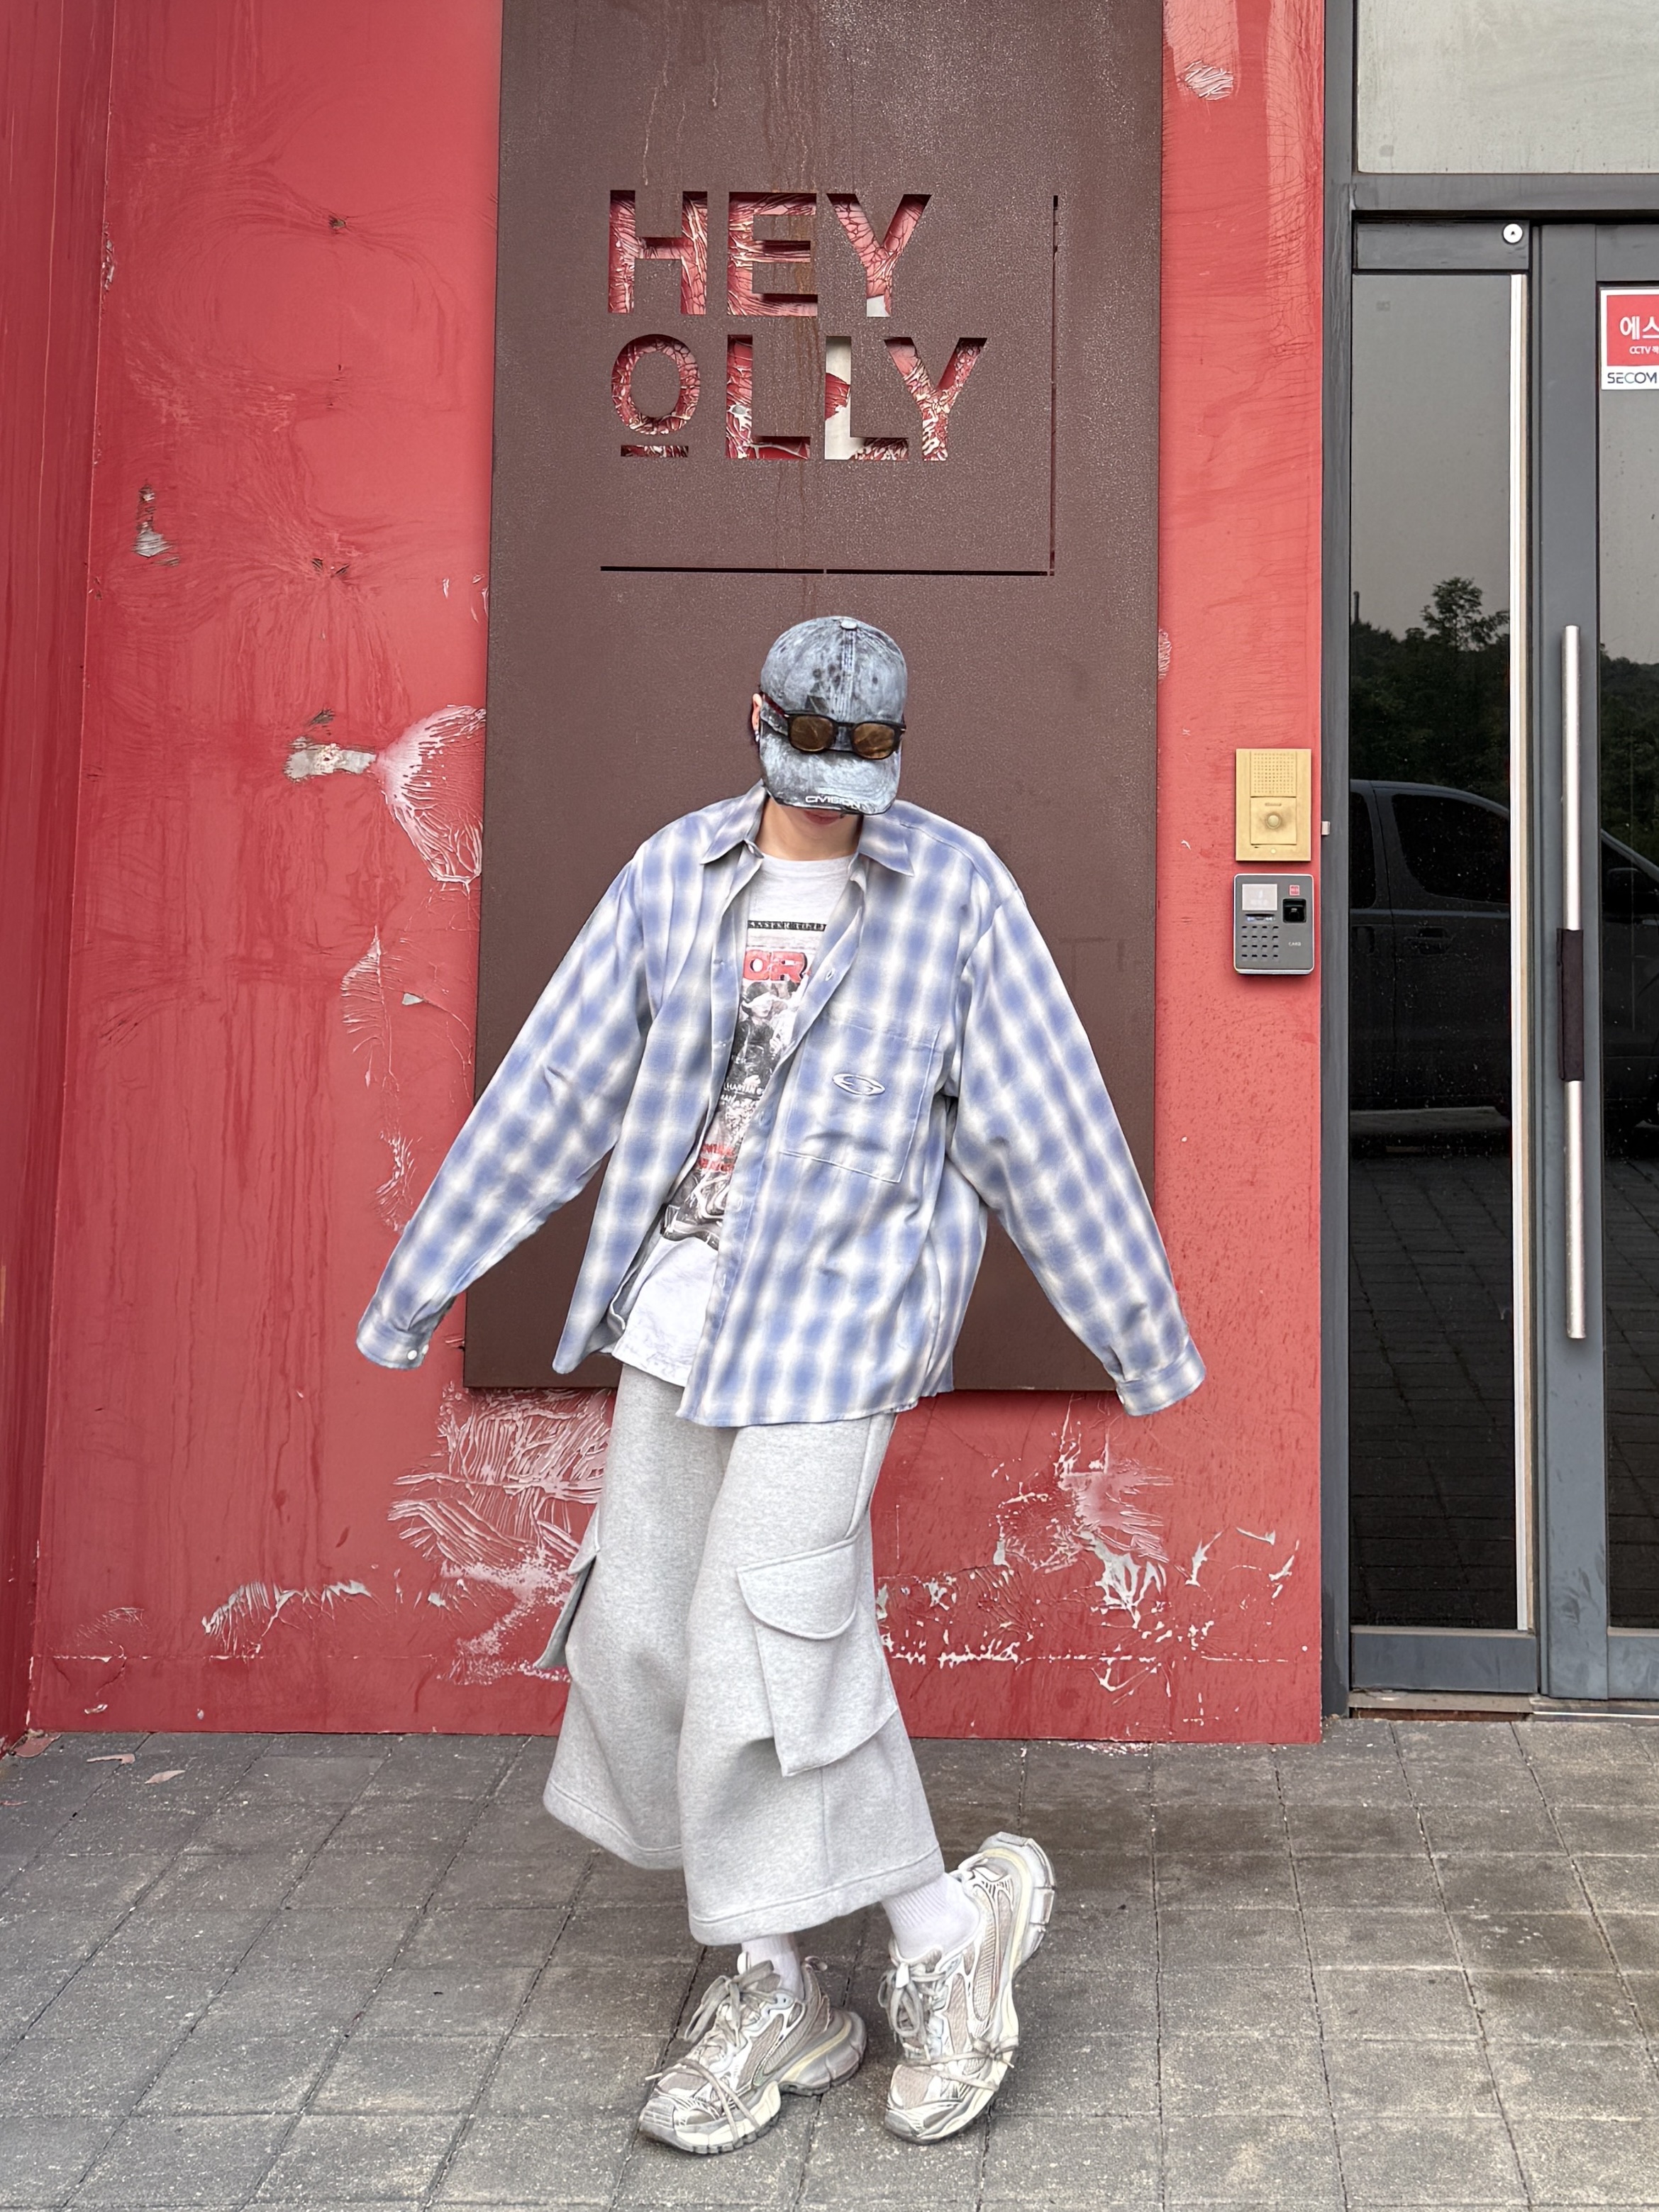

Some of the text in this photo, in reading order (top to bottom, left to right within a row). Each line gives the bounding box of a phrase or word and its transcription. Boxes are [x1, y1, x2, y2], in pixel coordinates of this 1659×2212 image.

[608, 189, 933, 318] HEY
[1607, 372, 1658, 384] SECOM
[1629, 345, 1651, 355] CCTV
[610, 333, 988, 461] OLLY
